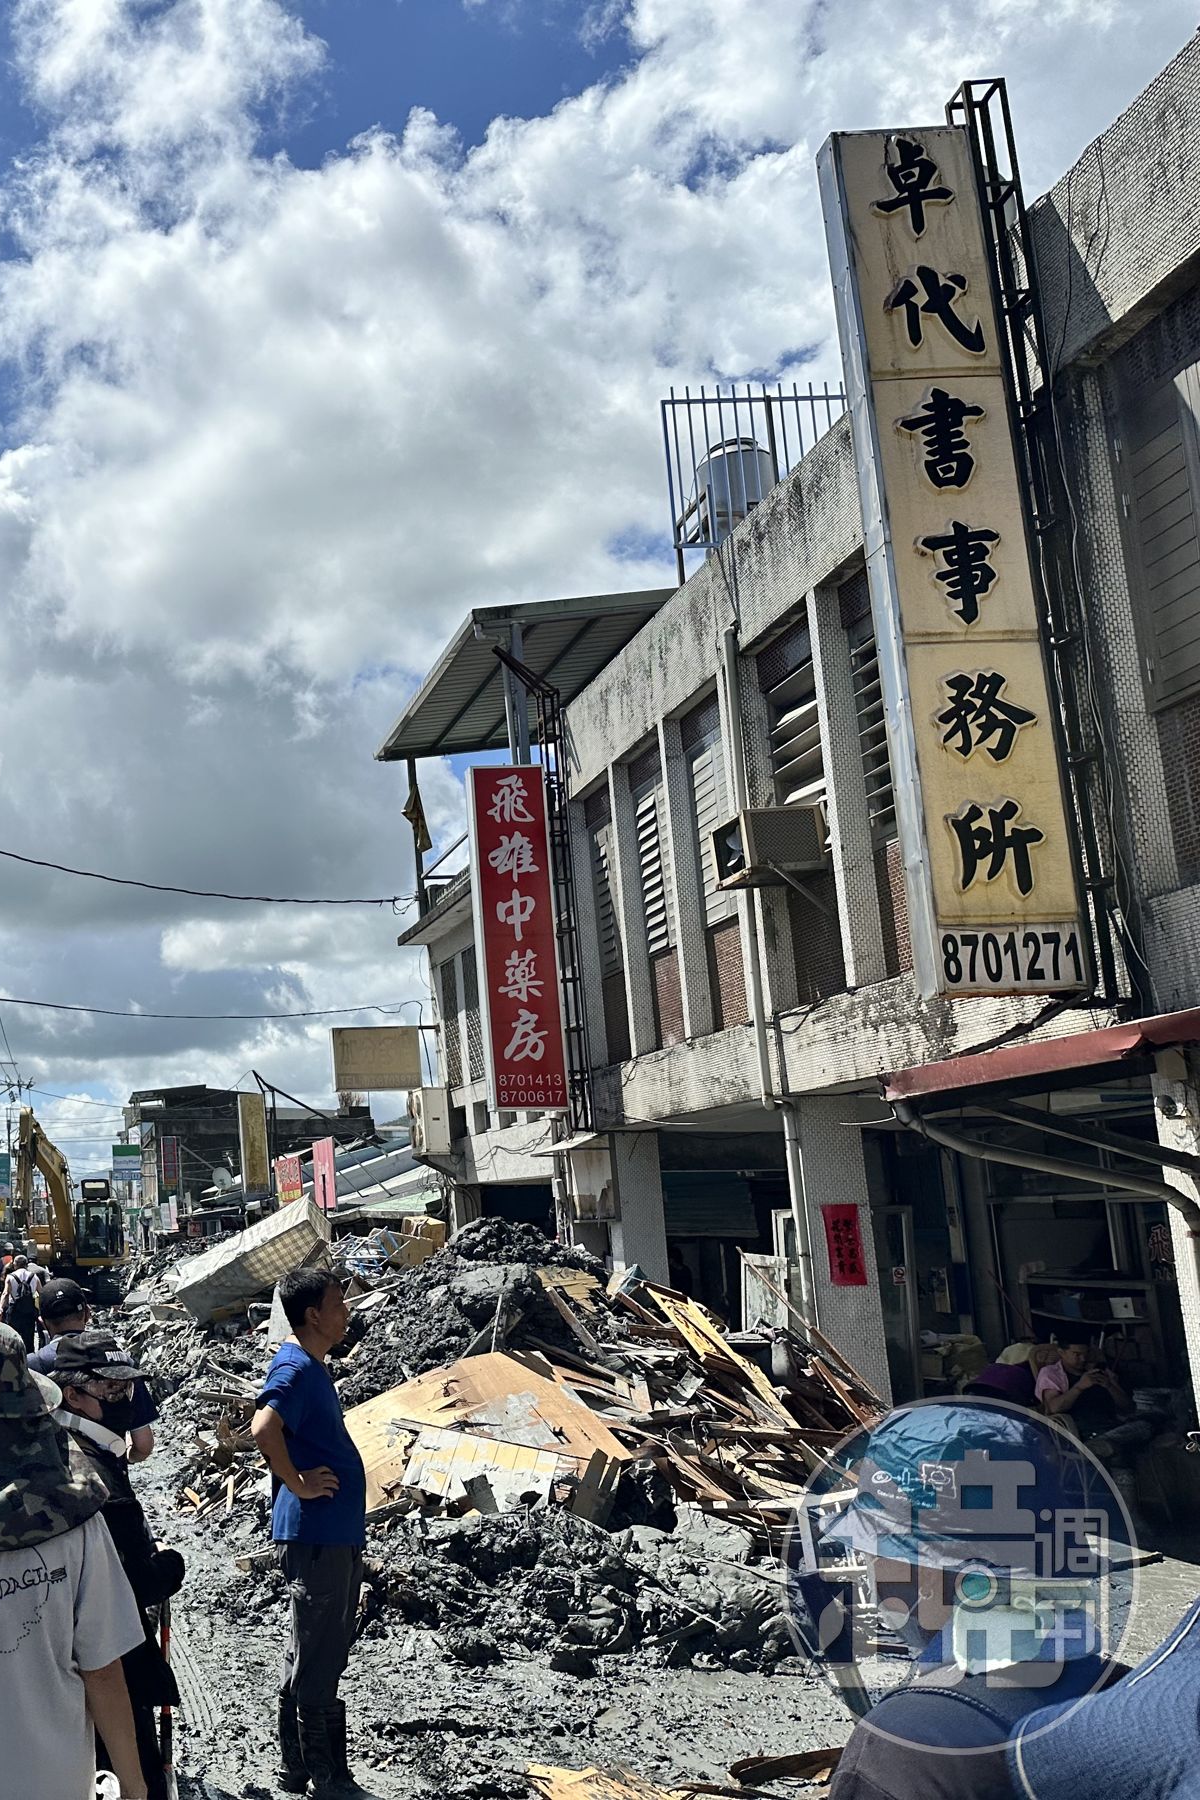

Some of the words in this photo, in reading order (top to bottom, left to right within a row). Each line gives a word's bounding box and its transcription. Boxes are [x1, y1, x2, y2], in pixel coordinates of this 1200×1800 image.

[873, 136, 1046, 897] 卓代書事務所
[487, 774, 549, 1062] 飛雄中藥房
[942, 931, 1083, 984] 8701271
[498, 1073, 562, 1087] 8701413
[499, 1089, 563, 1103] 8700617
